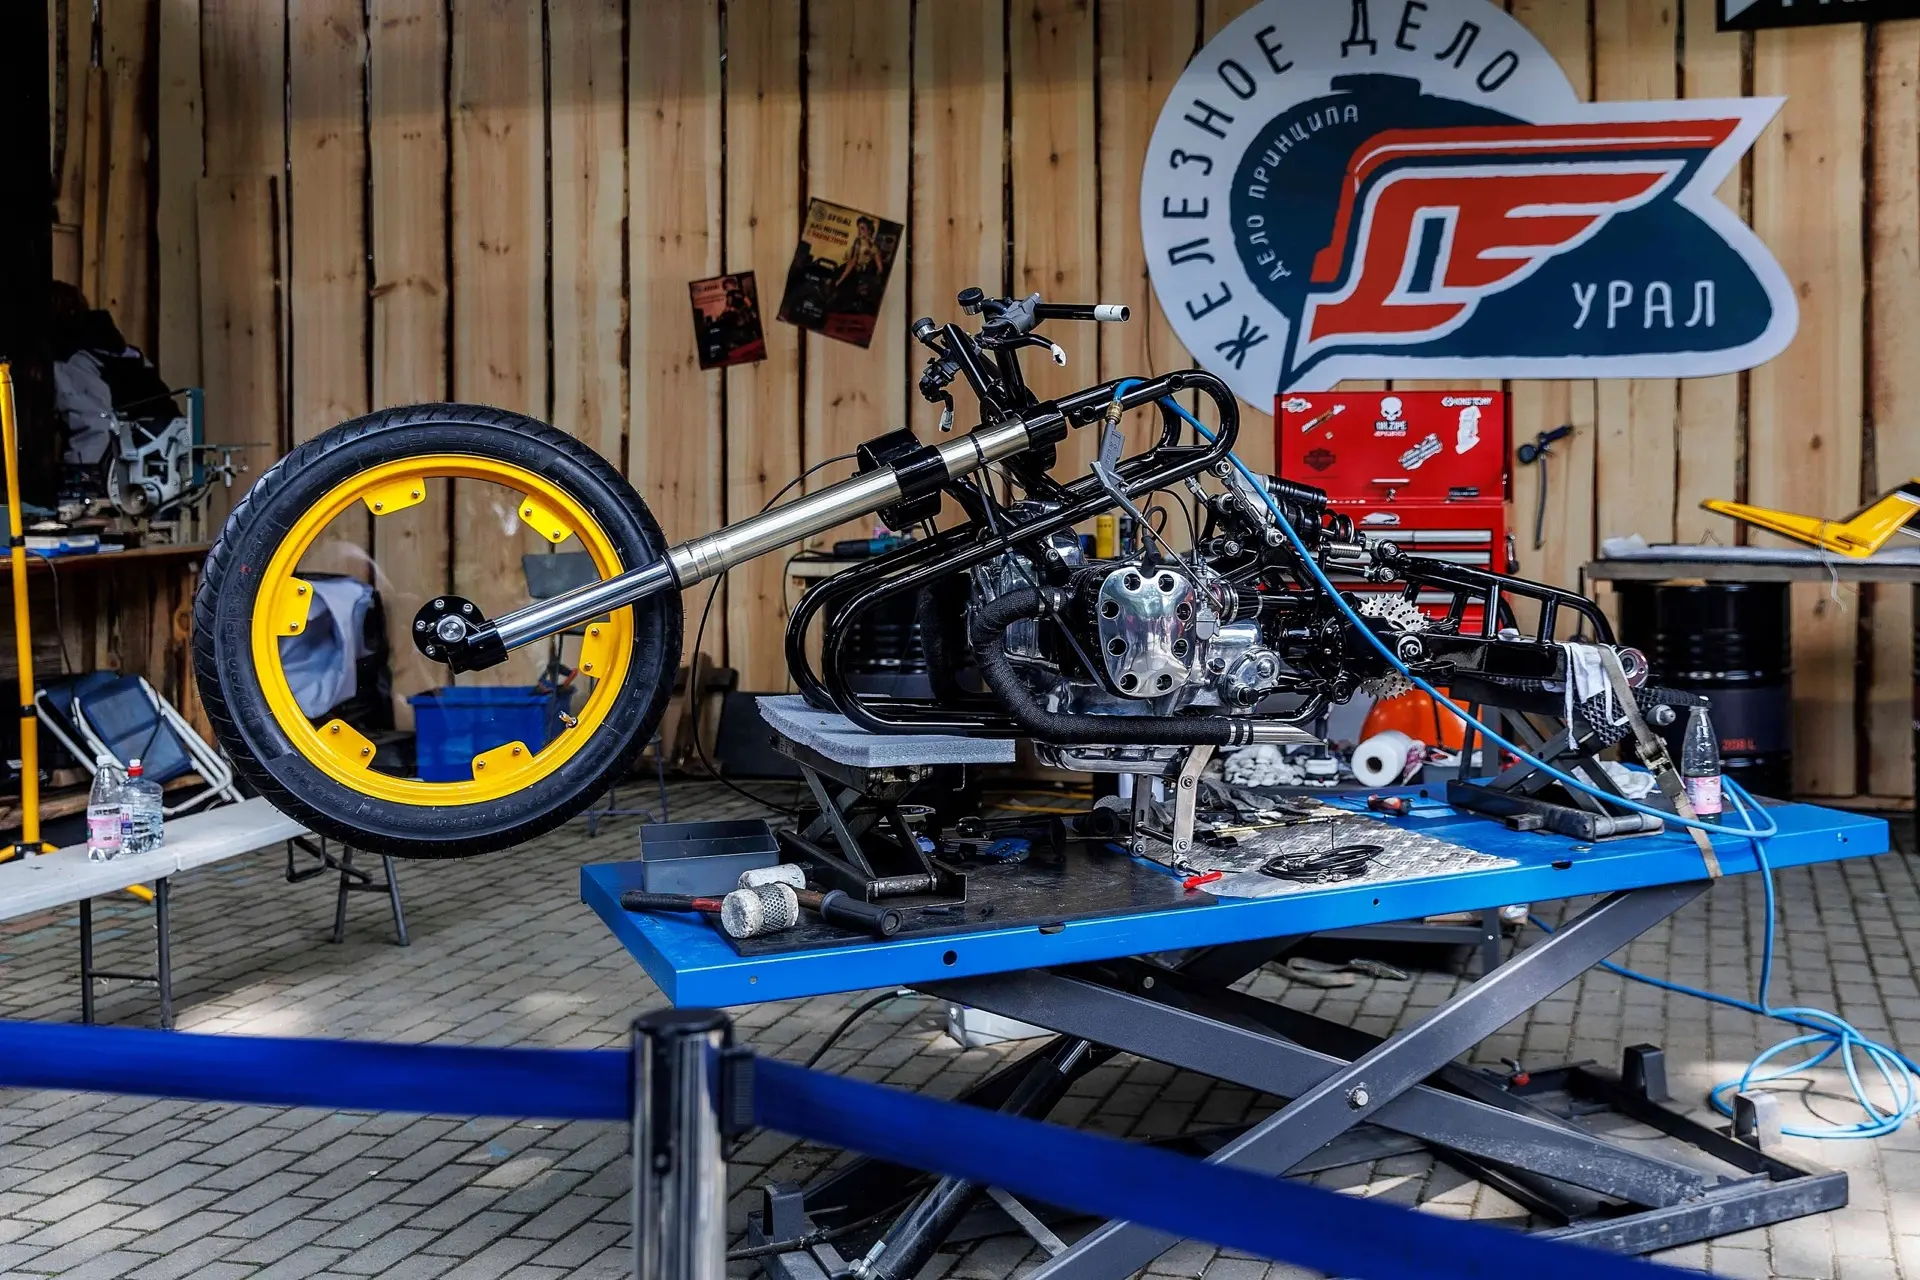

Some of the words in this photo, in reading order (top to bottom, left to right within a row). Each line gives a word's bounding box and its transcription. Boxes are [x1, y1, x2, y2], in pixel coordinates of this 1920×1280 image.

[1162, 24, 1294, 369] ЖЕЛЕЗНОЕ
[1340, 0, 1519, 92] ДЕЛО
[1248, 104, 1359, 199] ПРИНЦИПА
[1246, 215, 1292, 283] ДЕЛО
[1573, 280, 1716, 329] УРАЛ
